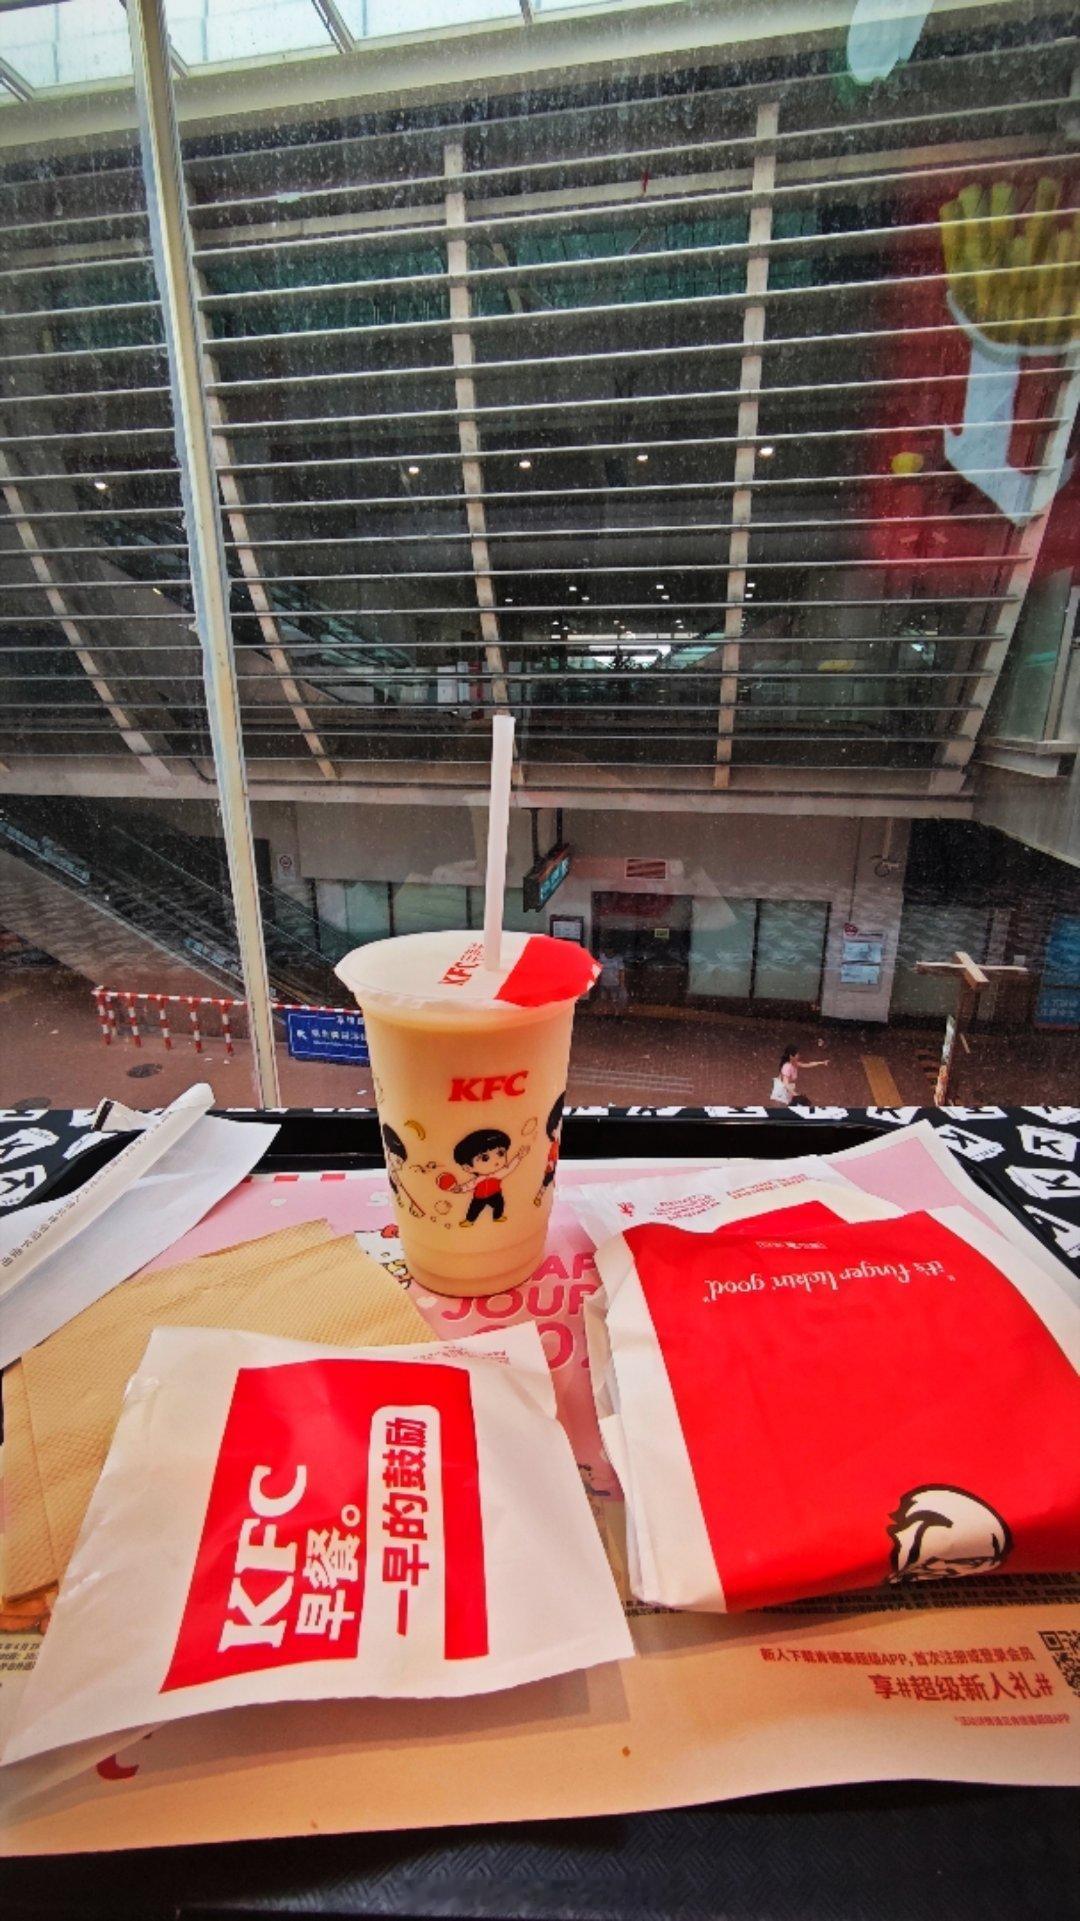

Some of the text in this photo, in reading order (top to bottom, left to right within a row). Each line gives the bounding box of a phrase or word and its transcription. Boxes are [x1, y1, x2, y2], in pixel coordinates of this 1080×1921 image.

[448, 1070, 528, 1102] KFC
[1032, 1135, 1065, 1156] K
[840, 1260, 911, 1284] finger
[382, 1416, 430, 1637] 一早的鼓励
[217, 1464, 307, 1654] KFC
[868, 1672, 1057, 1702] 享#超级新人礼#
